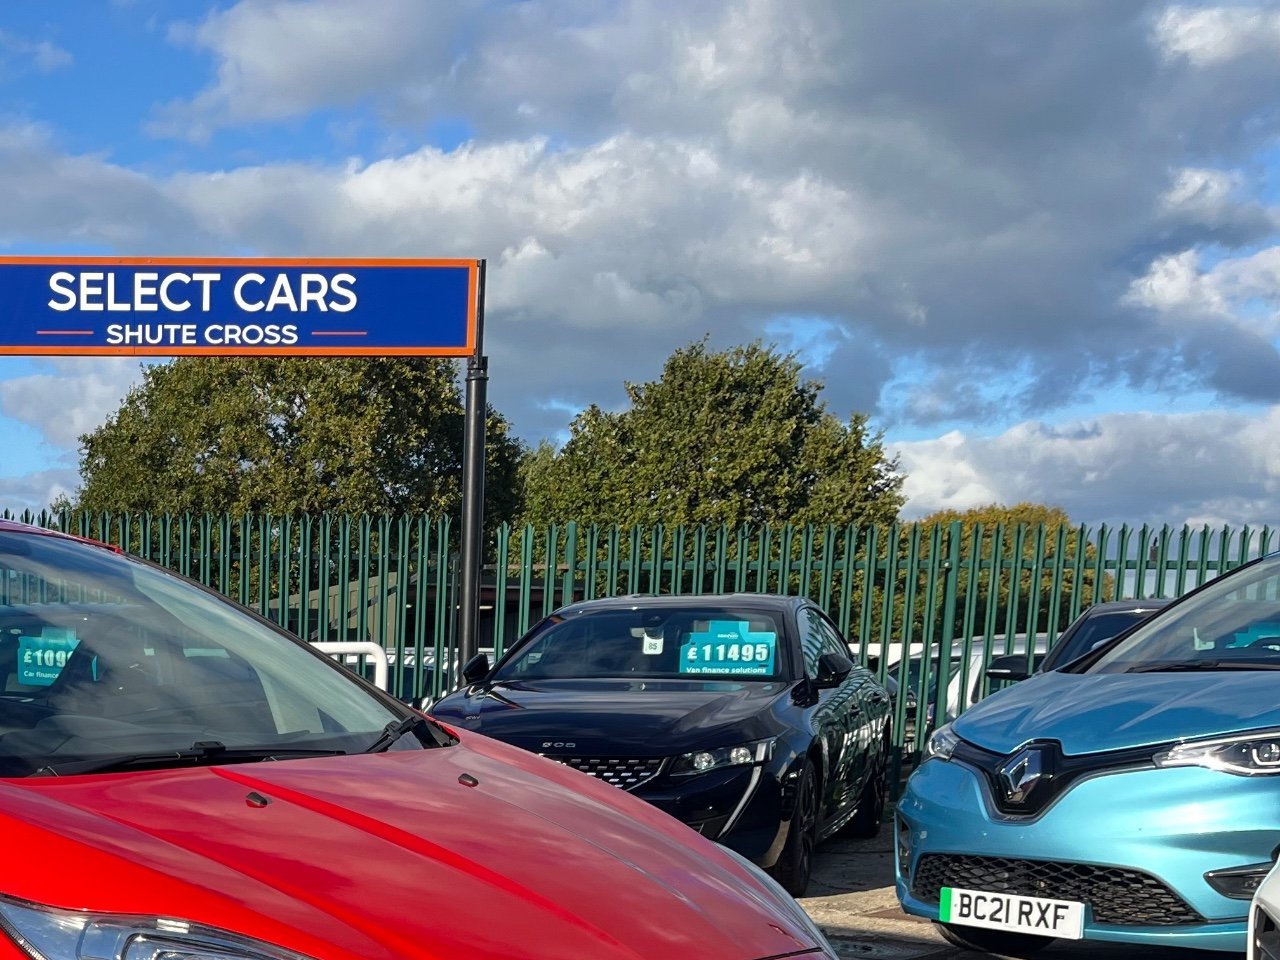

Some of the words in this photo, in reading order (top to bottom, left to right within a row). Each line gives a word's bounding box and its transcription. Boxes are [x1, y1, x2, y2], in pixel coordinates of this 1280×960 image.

[48, 272, 220, 312] SELECT
[234, 273, 357, 312] CARS
[106, 324, 197, 344] SHUTE
[204, 324, 298, 345] CROSS
[702, 666, 730, 674] finance
[958, 893, 1010, 924] BC21
[1017, 900, 1069, 930] RXF
